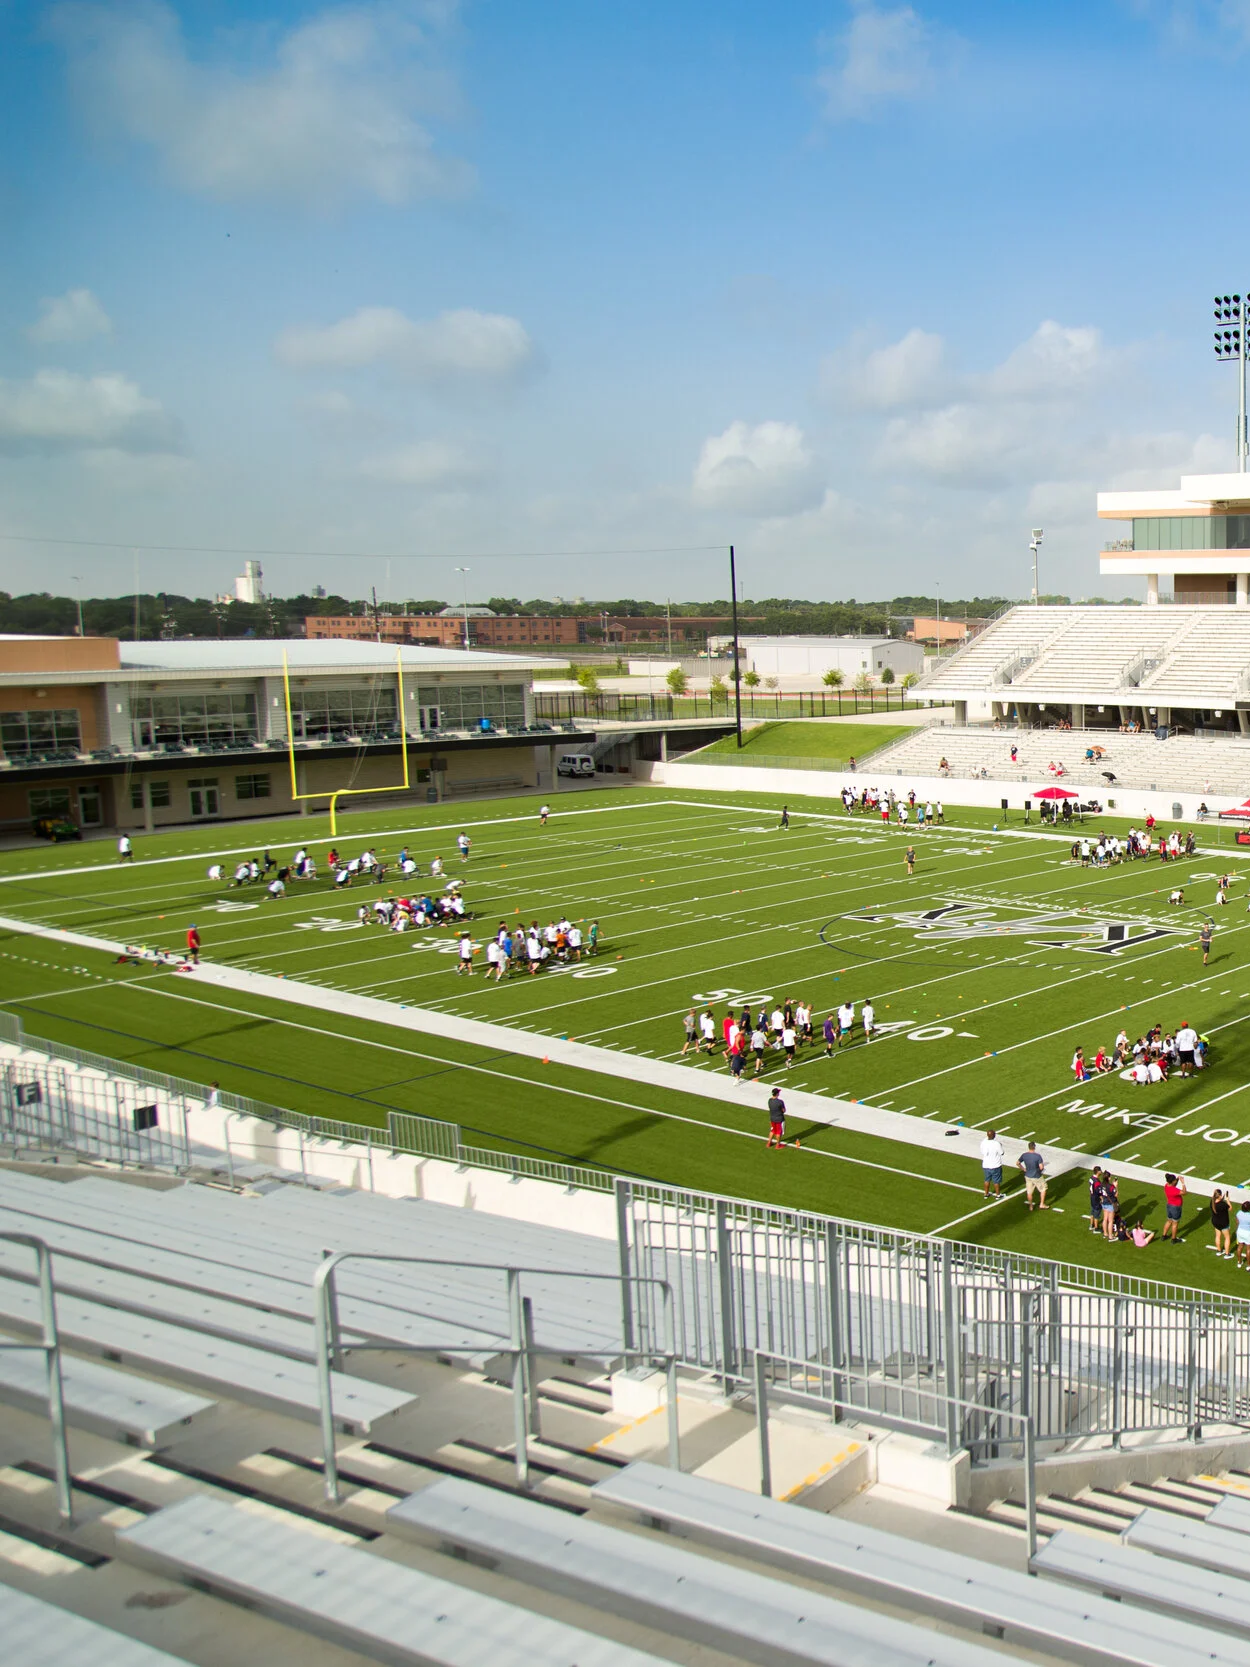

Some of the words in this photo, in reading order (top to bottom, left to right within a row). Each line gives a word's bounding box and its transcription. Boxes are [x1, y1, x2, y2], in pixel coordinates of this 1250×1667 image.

[293, 917, 364, 932] 20
[412, 937, 483, 953] 30
[692, 988, 774, 1008] 50
[872, 1020, 954, 1041] 40
[1056, 1099, 1174, 1130] MIKE
